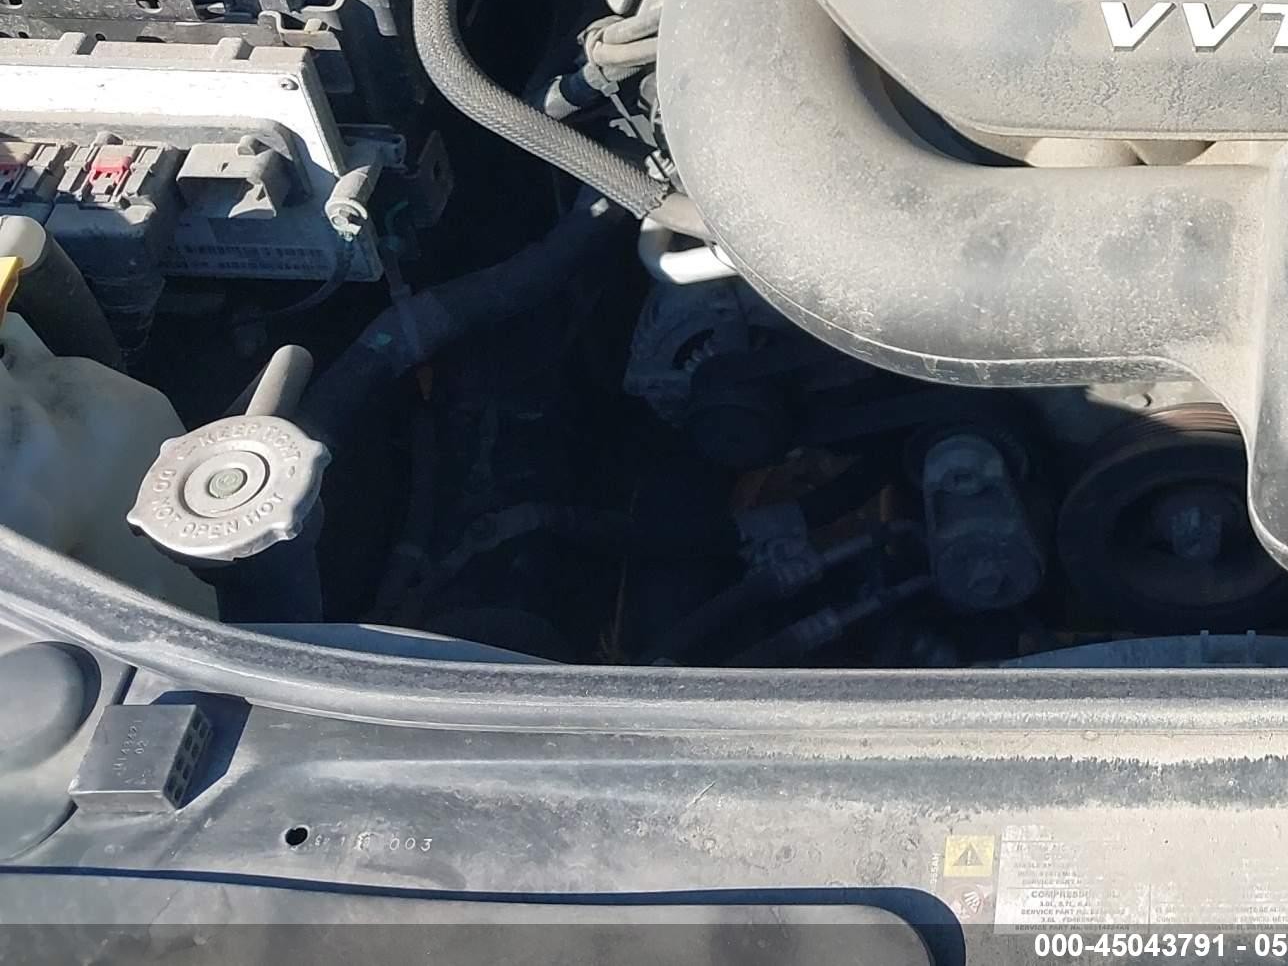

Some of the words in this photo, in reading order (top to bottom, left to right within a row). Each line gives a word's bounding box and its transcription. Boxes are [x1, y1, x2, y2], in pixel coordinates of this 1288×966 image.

[199, 422, 260, 448] KEEP
[183, 520, 240, 539] OPEN
[389, 838, 433, 852] 003
